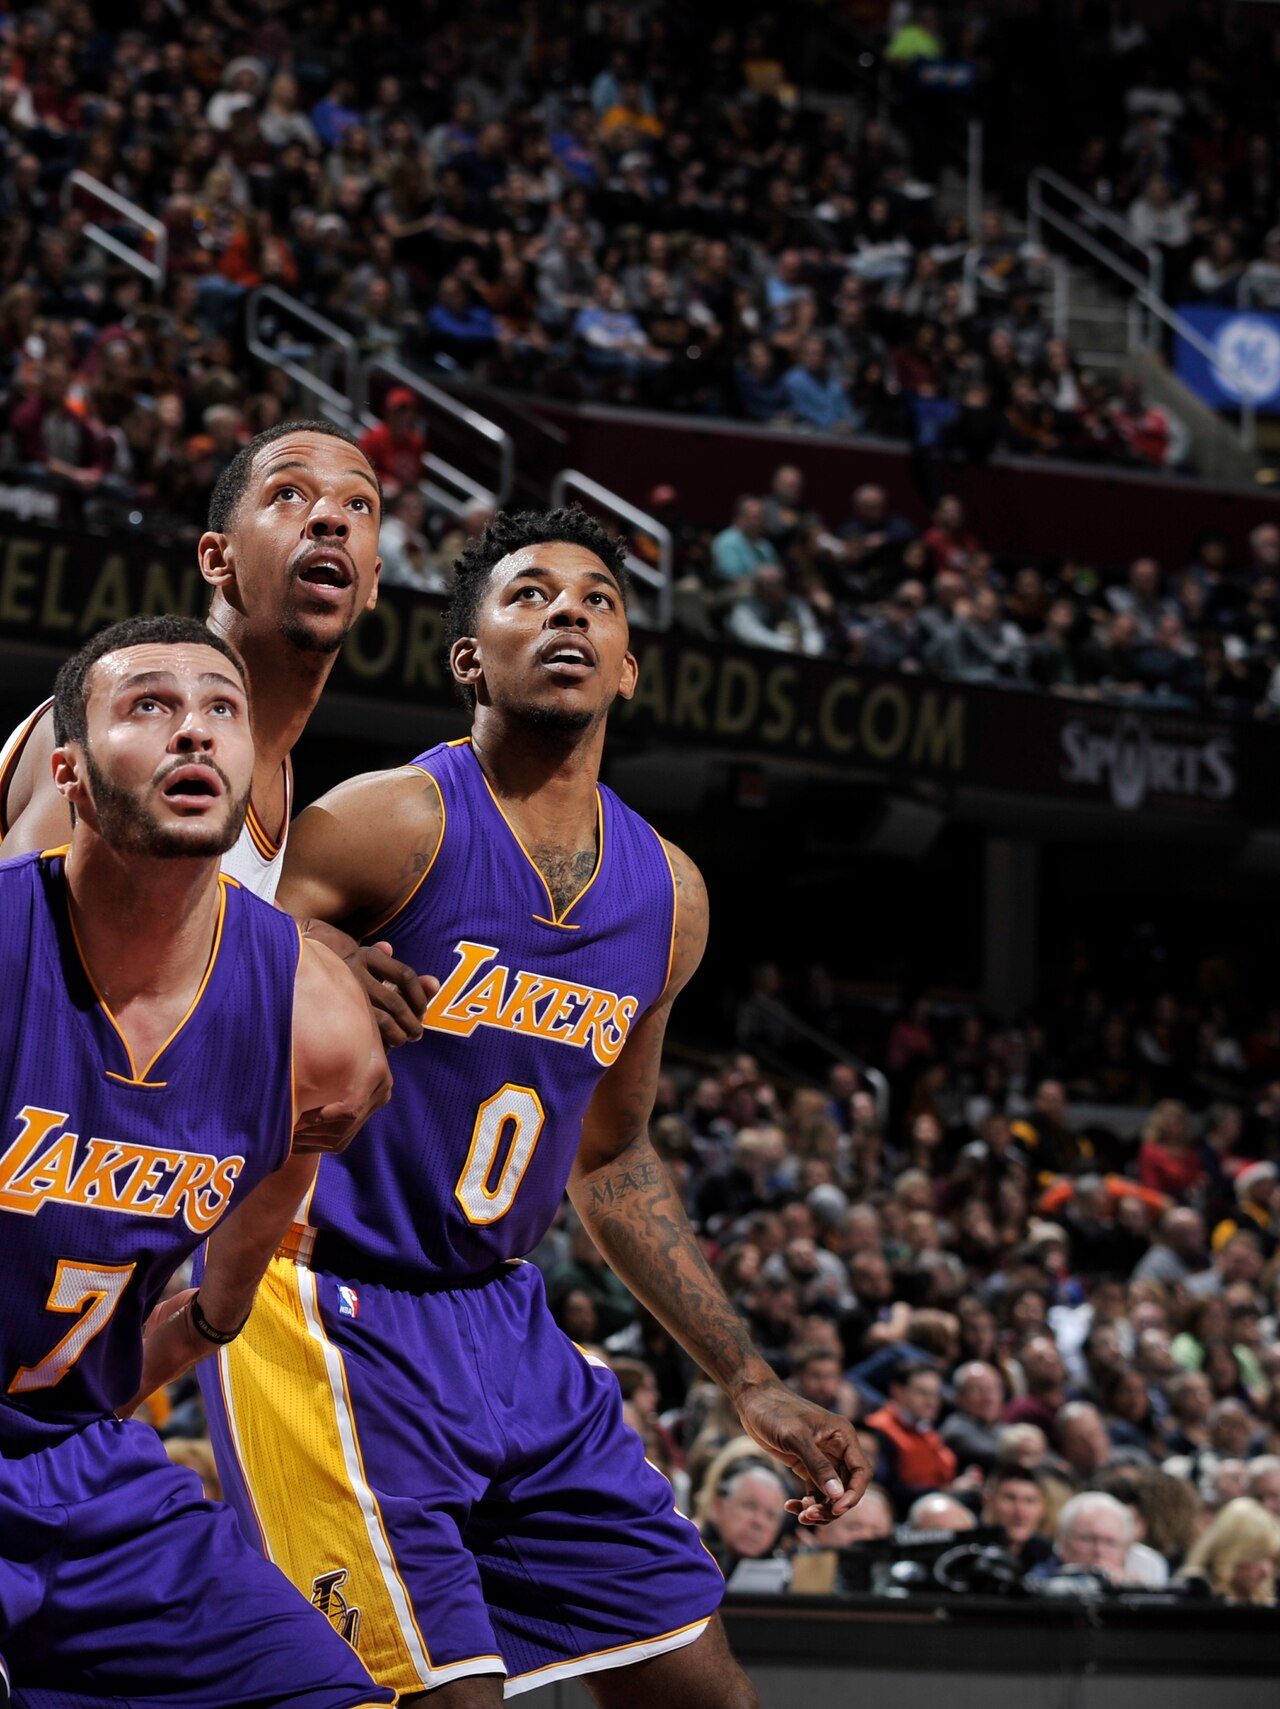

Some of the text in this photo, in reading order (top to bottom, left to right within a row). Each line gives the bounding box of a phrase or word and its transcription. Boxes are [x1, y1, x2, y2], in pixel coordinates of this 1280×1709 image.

[1059, 712, 1240, 812] SPORTS
[422, 940, 639, 1067] LAKERS
[454, 1082, 546, 1226] 0
[5, 1258, 139, 1395] 7
